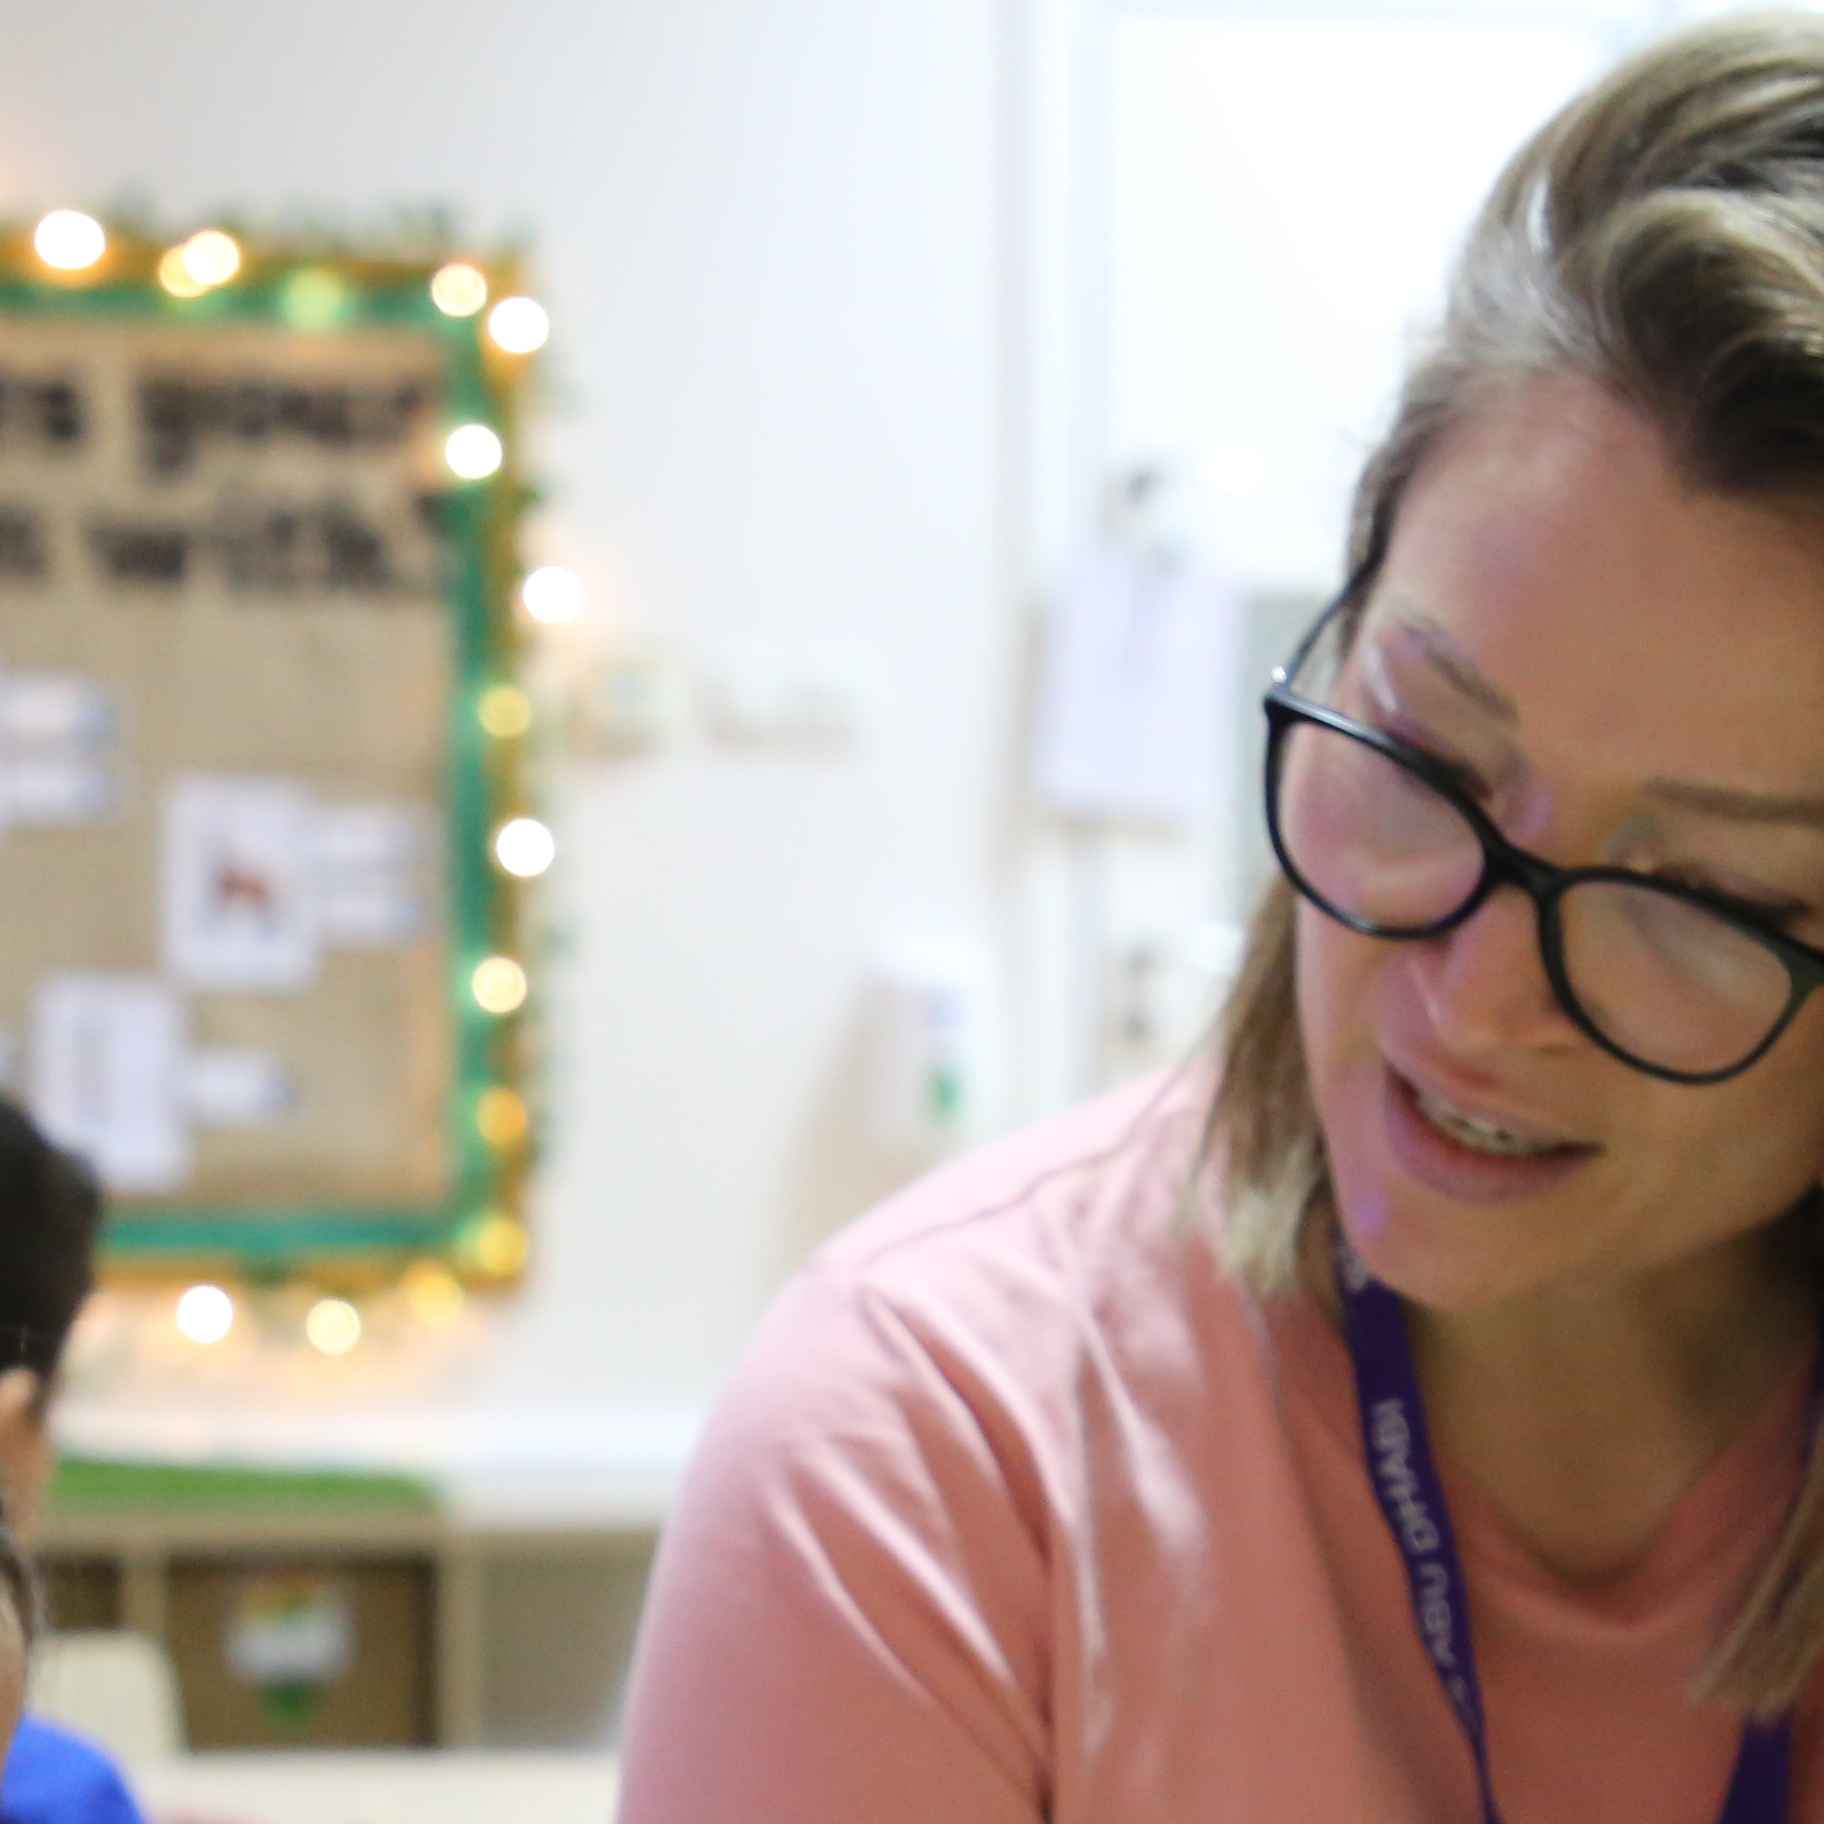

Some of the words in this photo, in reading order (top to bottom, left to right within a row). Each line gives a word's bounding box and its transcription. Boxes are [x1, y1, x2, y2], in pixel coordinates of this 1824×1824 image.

[136, 374, 428, 478] your
[1371, 1398, 1440, 1555] DHABI
[1417, 1563, 1457, 1668] ABU
